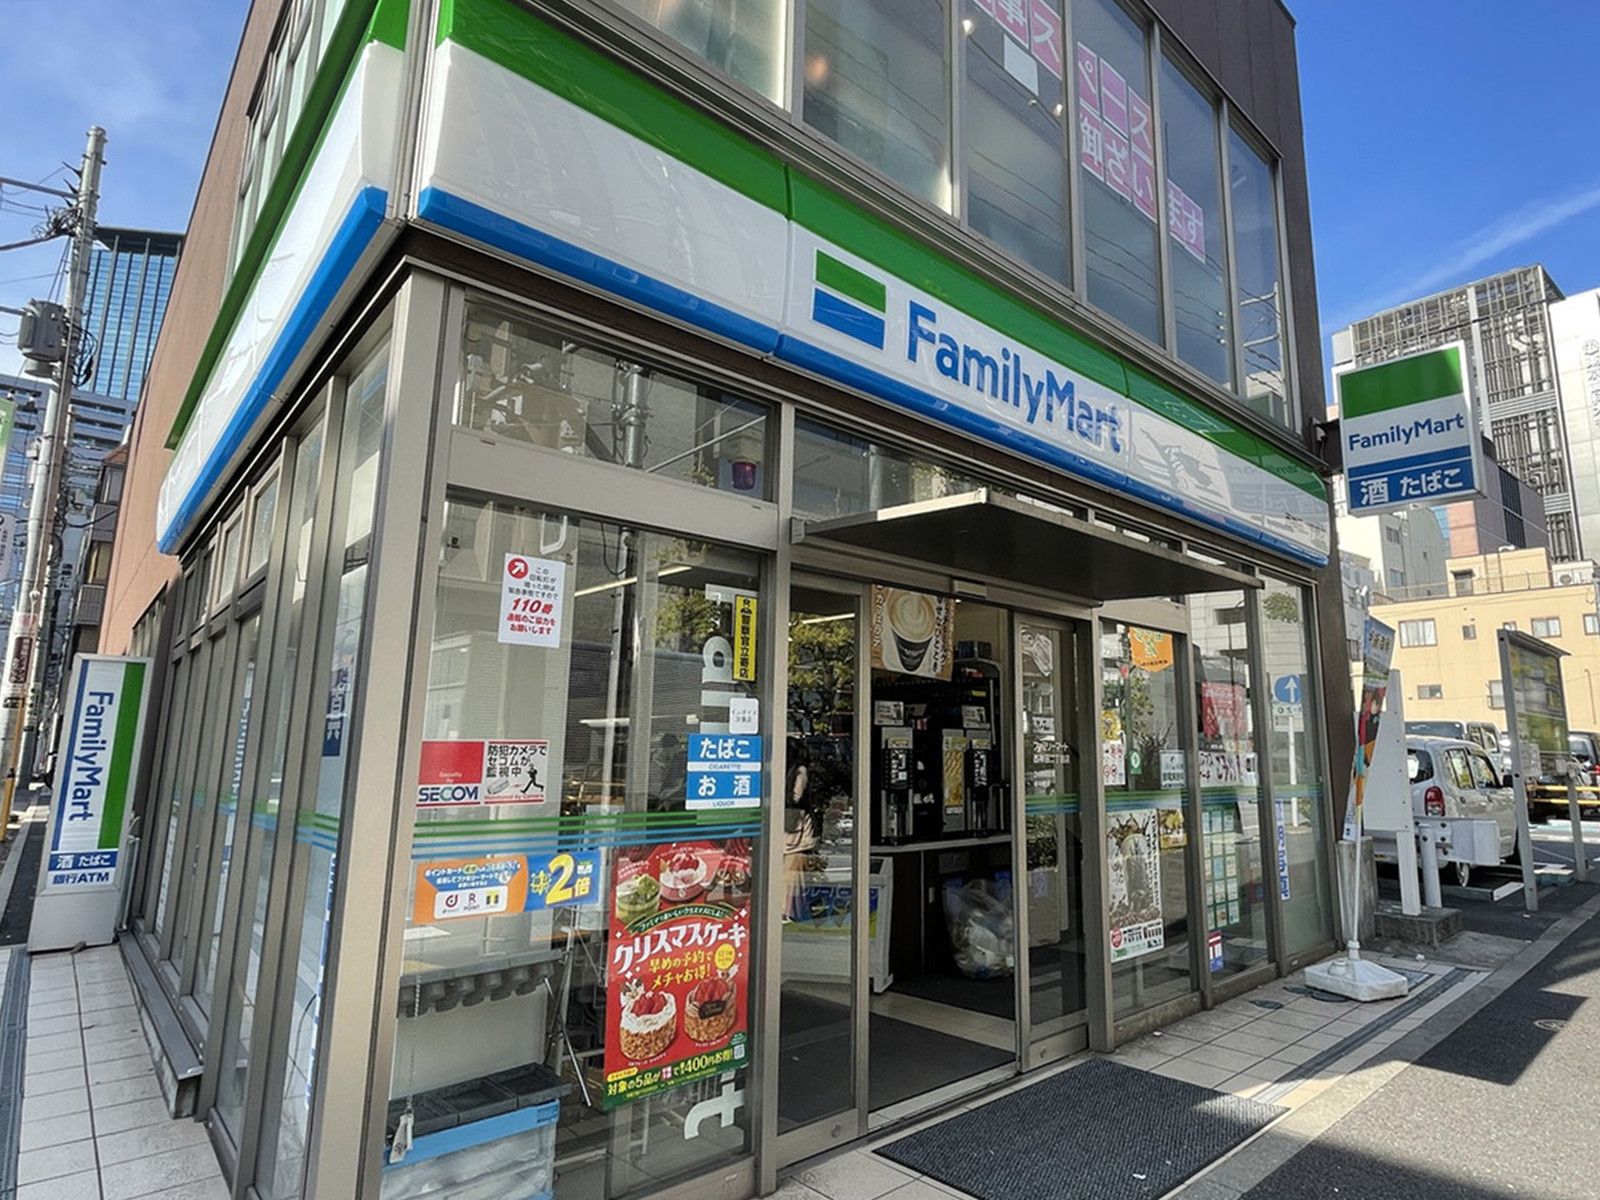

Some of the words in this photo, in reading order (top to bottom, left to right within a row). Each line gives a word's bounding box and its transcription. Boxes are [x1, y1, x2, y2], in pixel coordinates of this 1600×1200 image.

[907, 300, 1121, 453] FamilyMart
[1349, 413, 1464, 451] FamilyMart
[1360, 478, 1389, 505] 酒
[1400, 468, 1462, 497] たばこ
[512, 597, 553, 615] 110番
[69, 691, 114, 822] FamilyMart
[488, 745, 546, 756] 防犯カメラで
[700, 737, 750, 759] たばこ
[488, 757, 530, 767] セコムが
[418, 786, 478, 802] SECOM
[698, 774, 751, 796] お酒
[57, 855, 74, 869] 酒
[78, 854, 111, 867] たばこ
[52, 871, 110, 885] 銀行ATM
[614, 922, 747, 974] クリスマスケーキ
[650, 950, 713, 973] 早めの予約で
